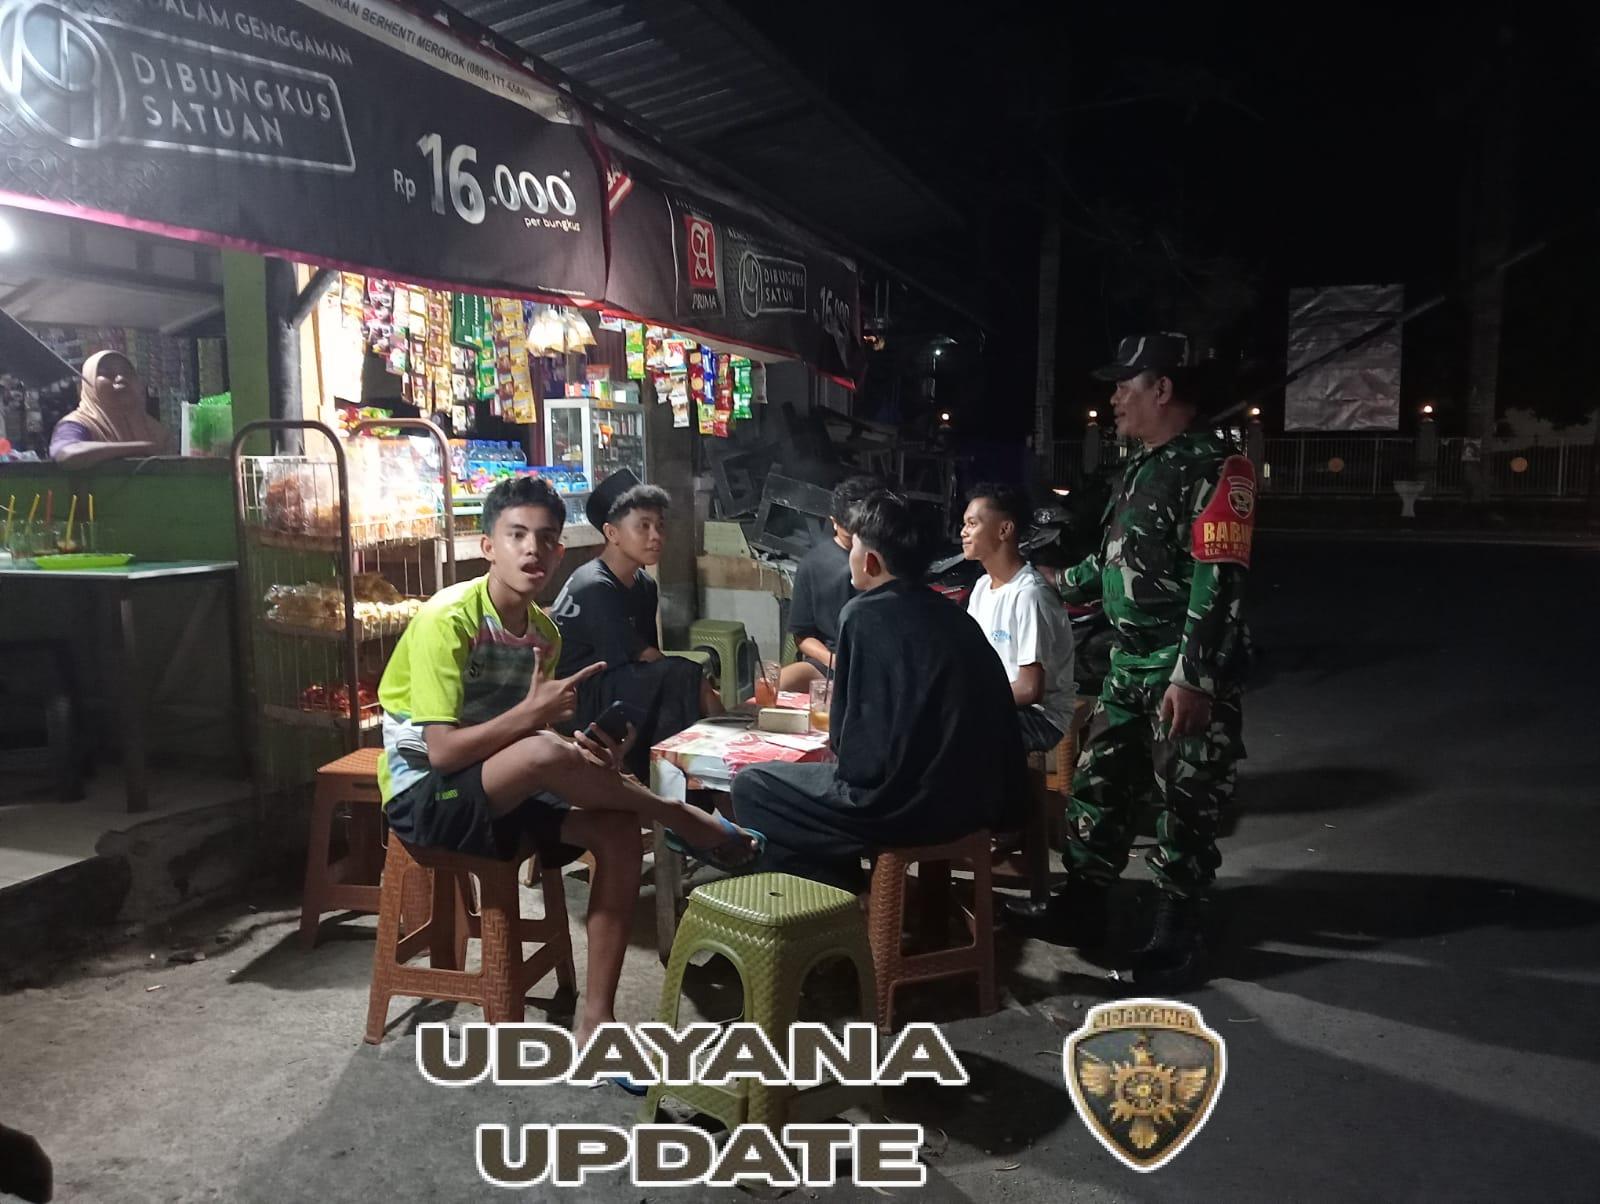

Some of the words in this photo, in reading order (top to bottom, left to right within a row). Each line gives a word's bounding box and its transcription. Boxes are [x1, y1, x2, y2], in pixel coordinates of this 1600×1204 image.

[234, 12, 353, 65] GENGGAMAN
[361, 8, 415, 43] BERHENTI
[416, 36, 465, 68] MEROKOK
[130, 51, 332, 121] DIBUNGKUS
[142, 95, 285, 147] SATUAN
[393, 168, 417, 203] Rp
[524, 216, 541, 228] per
[542, 217, 581, 232] bungkus
[691, 292, 718, 310] PRIMA
